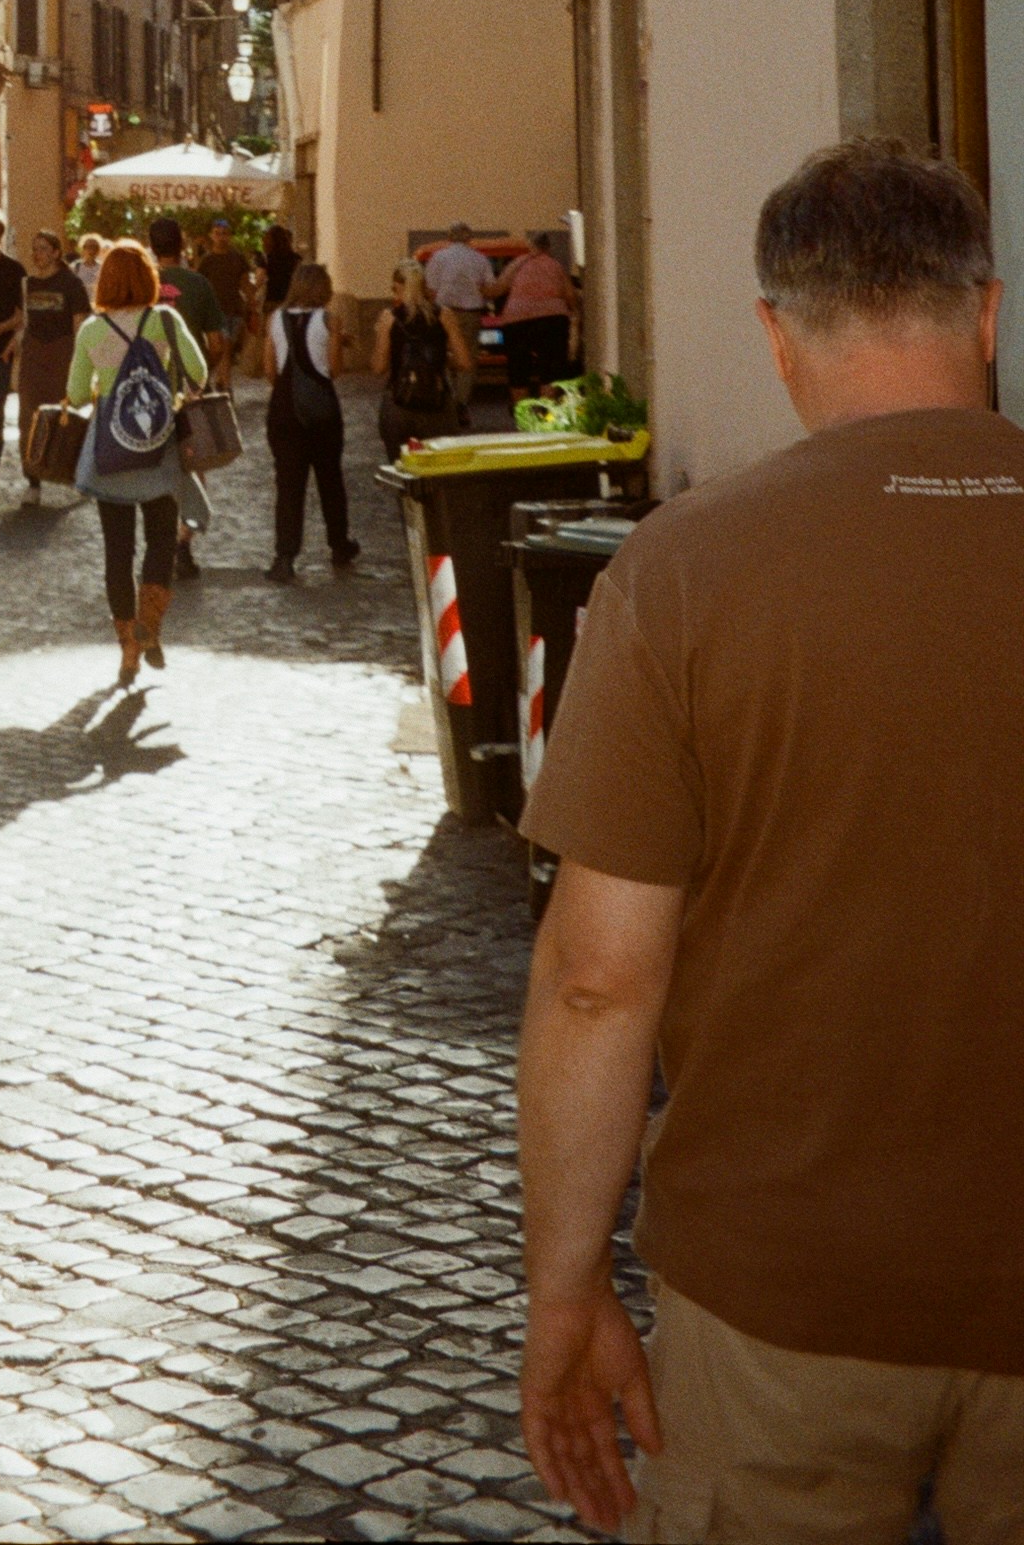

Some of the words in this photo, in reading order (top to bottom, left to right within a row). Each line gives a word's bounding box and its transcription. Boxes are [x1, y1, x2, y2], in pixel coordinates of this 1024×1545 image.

[129, 183, 253, 205] RISTORANTE
[891, 475, 943, 486] Freedom
[946, 478, 960, 486] in
[961, 477, 981, 486] the
[883, 484, 896, 494] of
[899, 485, 963, 496] movement
[965, 485, 989, 496] and
